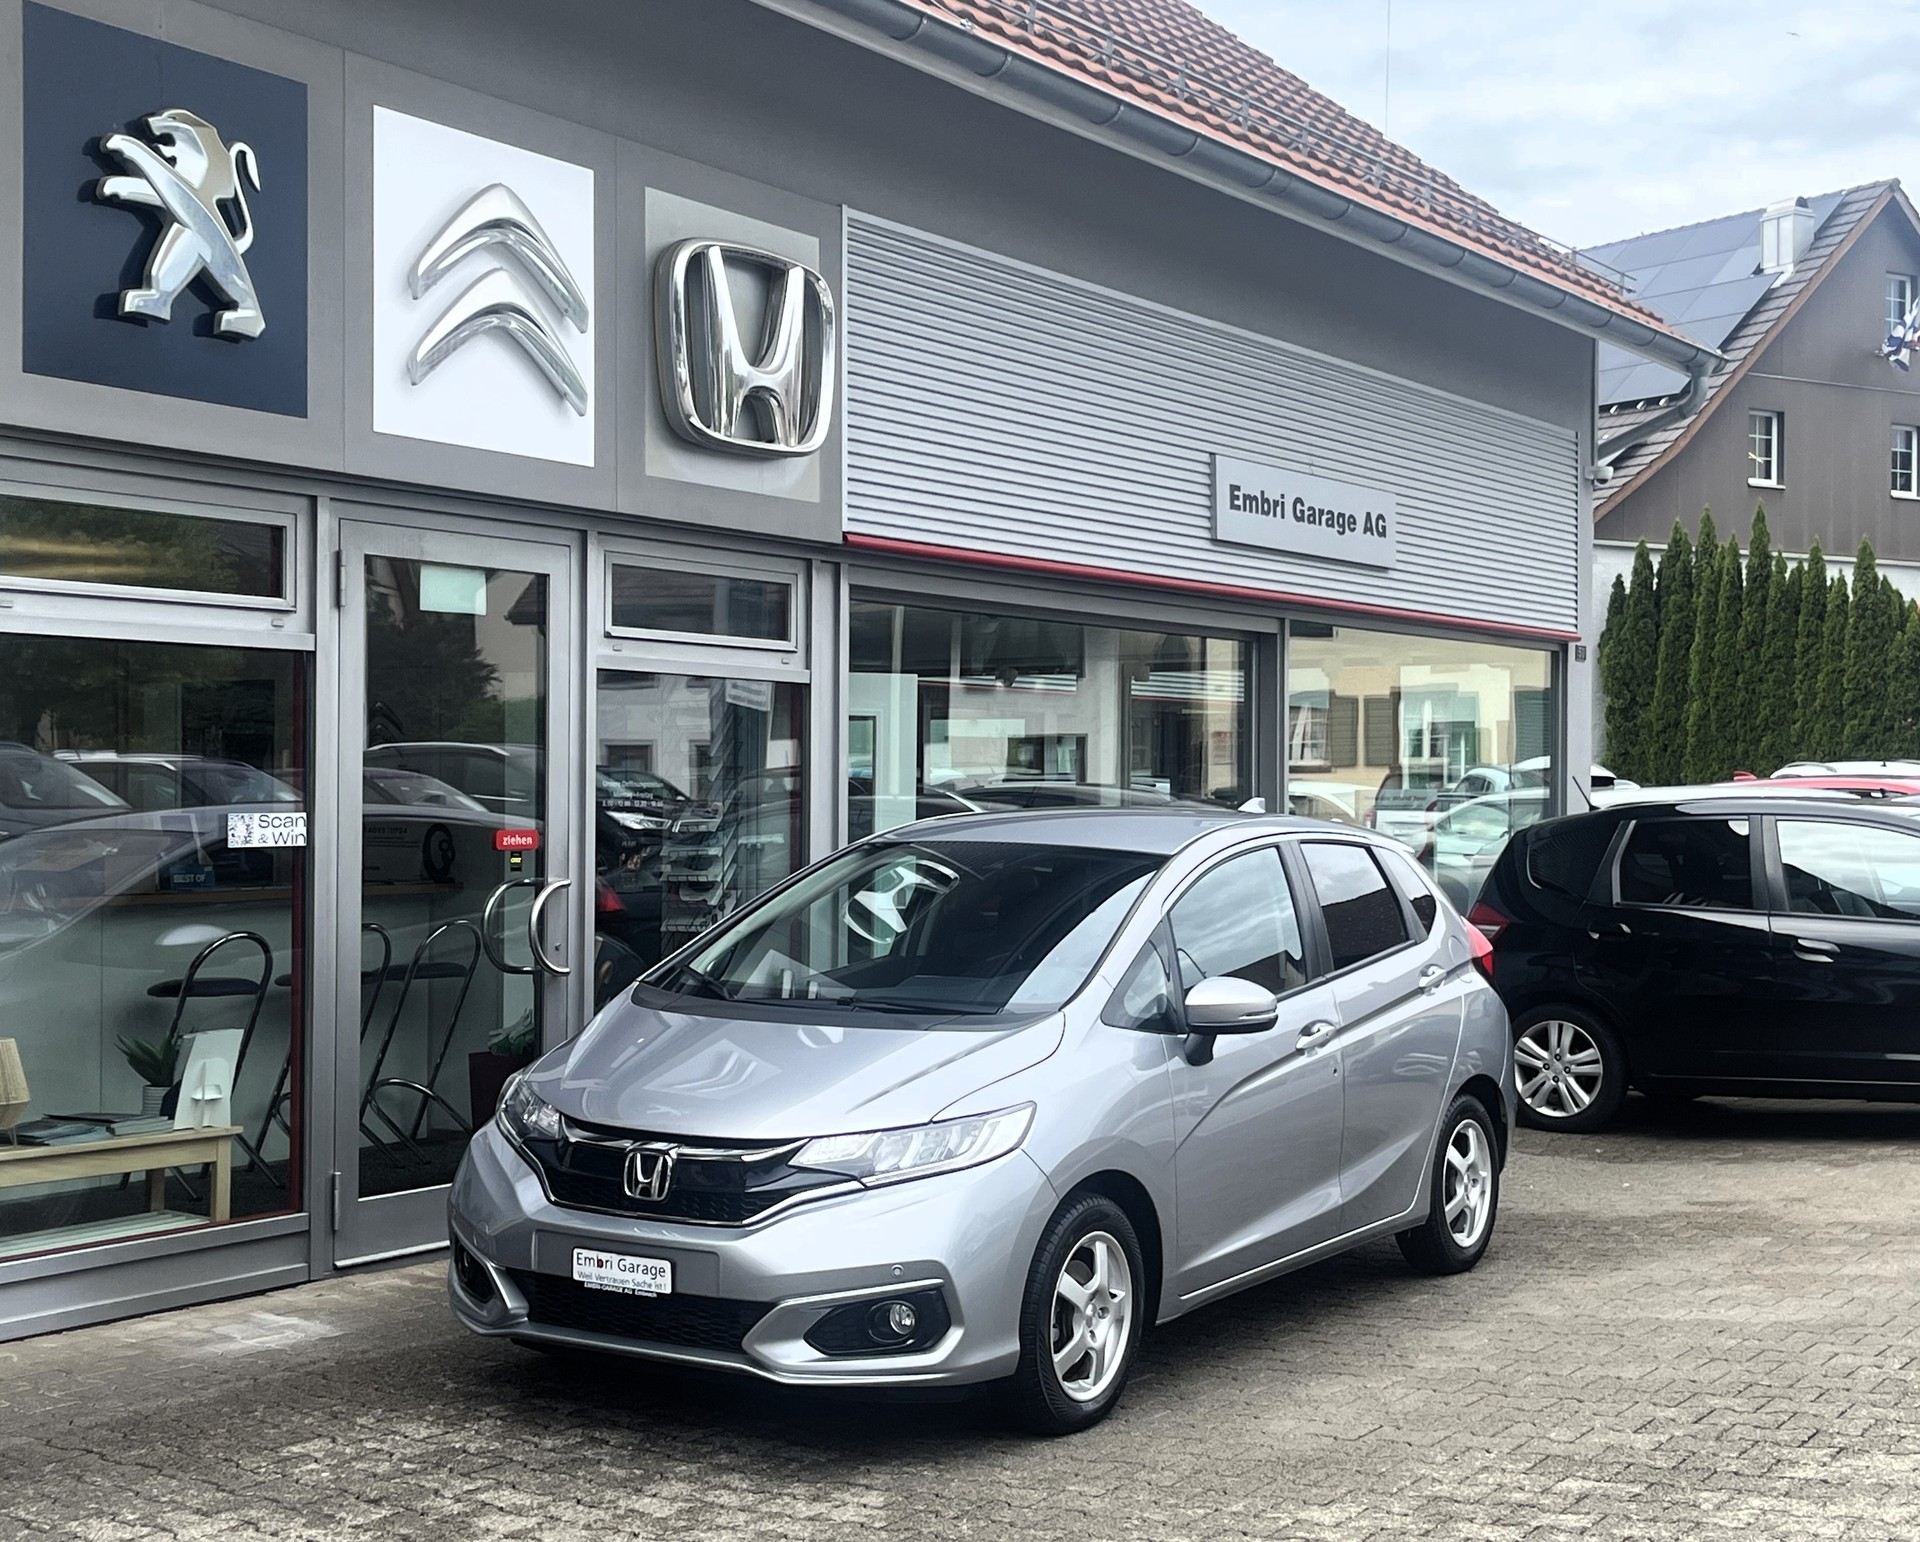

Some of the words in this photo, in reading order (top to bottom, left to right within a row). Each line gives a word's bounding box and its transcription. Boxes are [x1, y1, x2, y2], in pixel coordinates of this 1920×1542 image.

[1229, 483, 1285, 519] Embri
[1292, 497, 1357, 536] Garage
[1363, 511, 1387, 538] AG
[258, 814, 306, 829] Scan
[257, 833, 269, 845] &
[272, 829, 306, 845] Win
[502, 834, 533, 846] ziehen
[173, 874, 194, 884] BEST
[576, 1252, 614, 1270] Embri
[617, 1258, 666, 1281] Garage
[577, 1270, 593, 1281] Weil
[595, 1273, 630, 1286] Vertrauen
[632, 1277, 652, 1290] Sache
